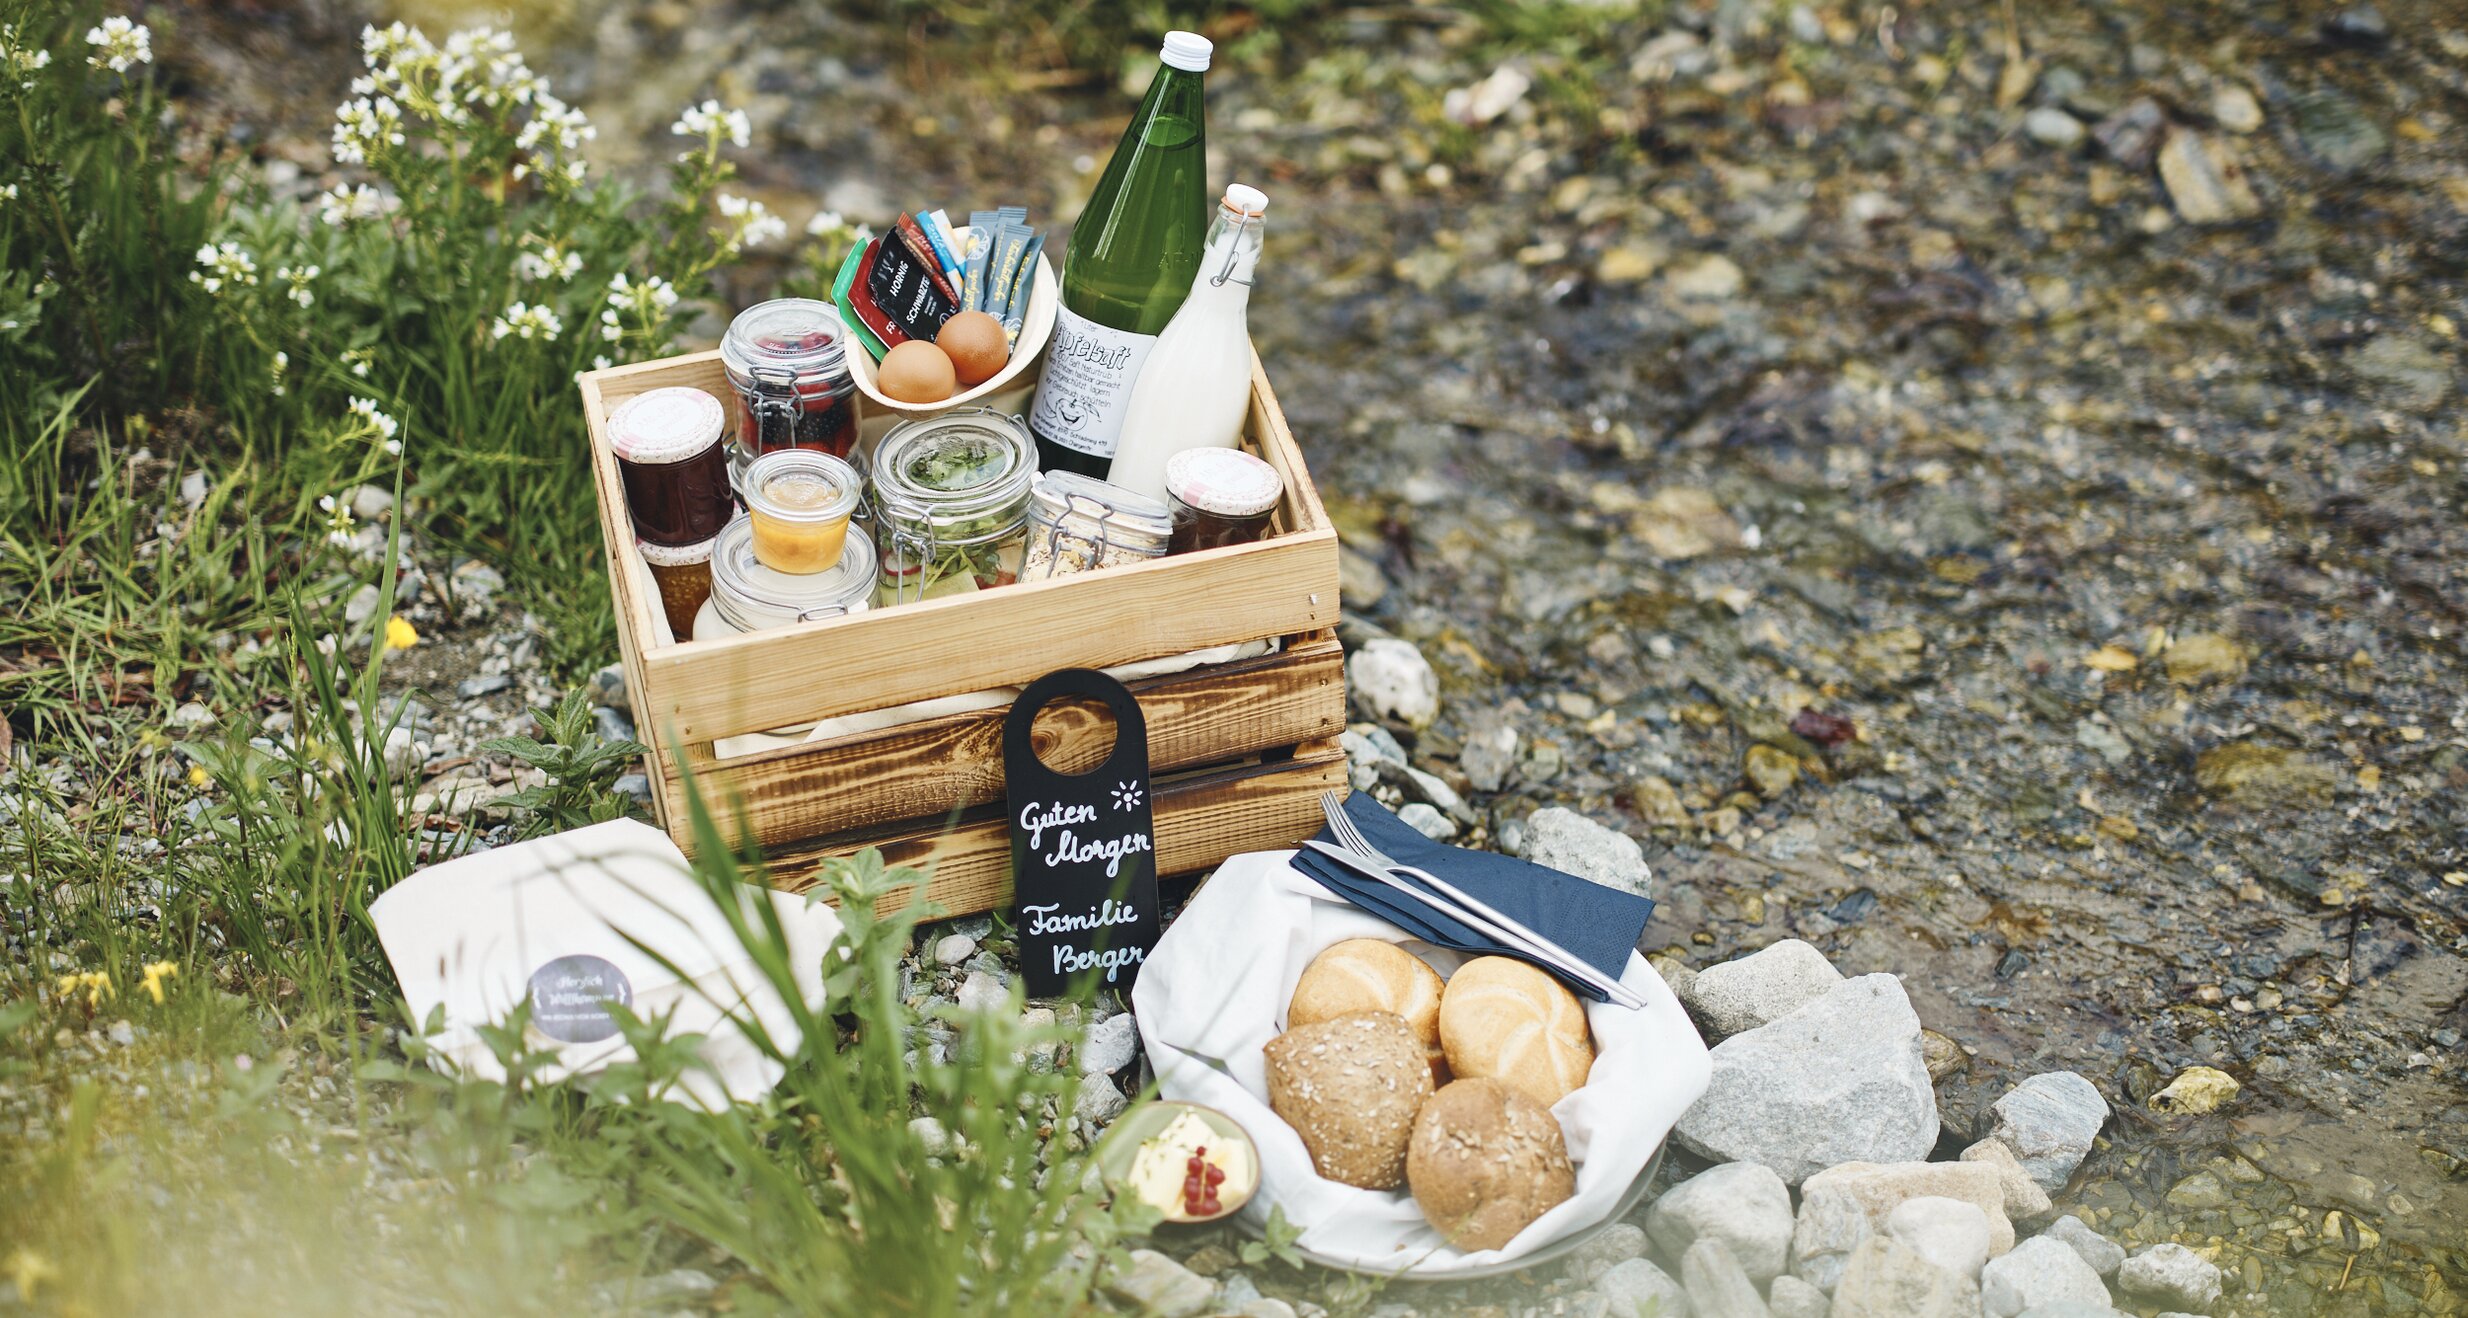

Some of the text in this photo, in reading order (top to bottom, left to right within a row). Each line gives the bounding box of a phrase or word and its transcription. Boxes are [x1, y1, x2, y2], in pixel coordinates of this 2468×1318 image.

[889, 260, 909, 297] HORNIG
[1053, 321, 1131, 370] Apfelsaft
[1069, 359, 1080, 369] Saft
[1091, 384, 1111, 397] lagern
[1020, 801, 1097, 850] Guten
[1045, 830, 1151, 878] Morgen
[1022, 899, 1138, 936] Familie
[1052, 944, 1145, 983] Berger
